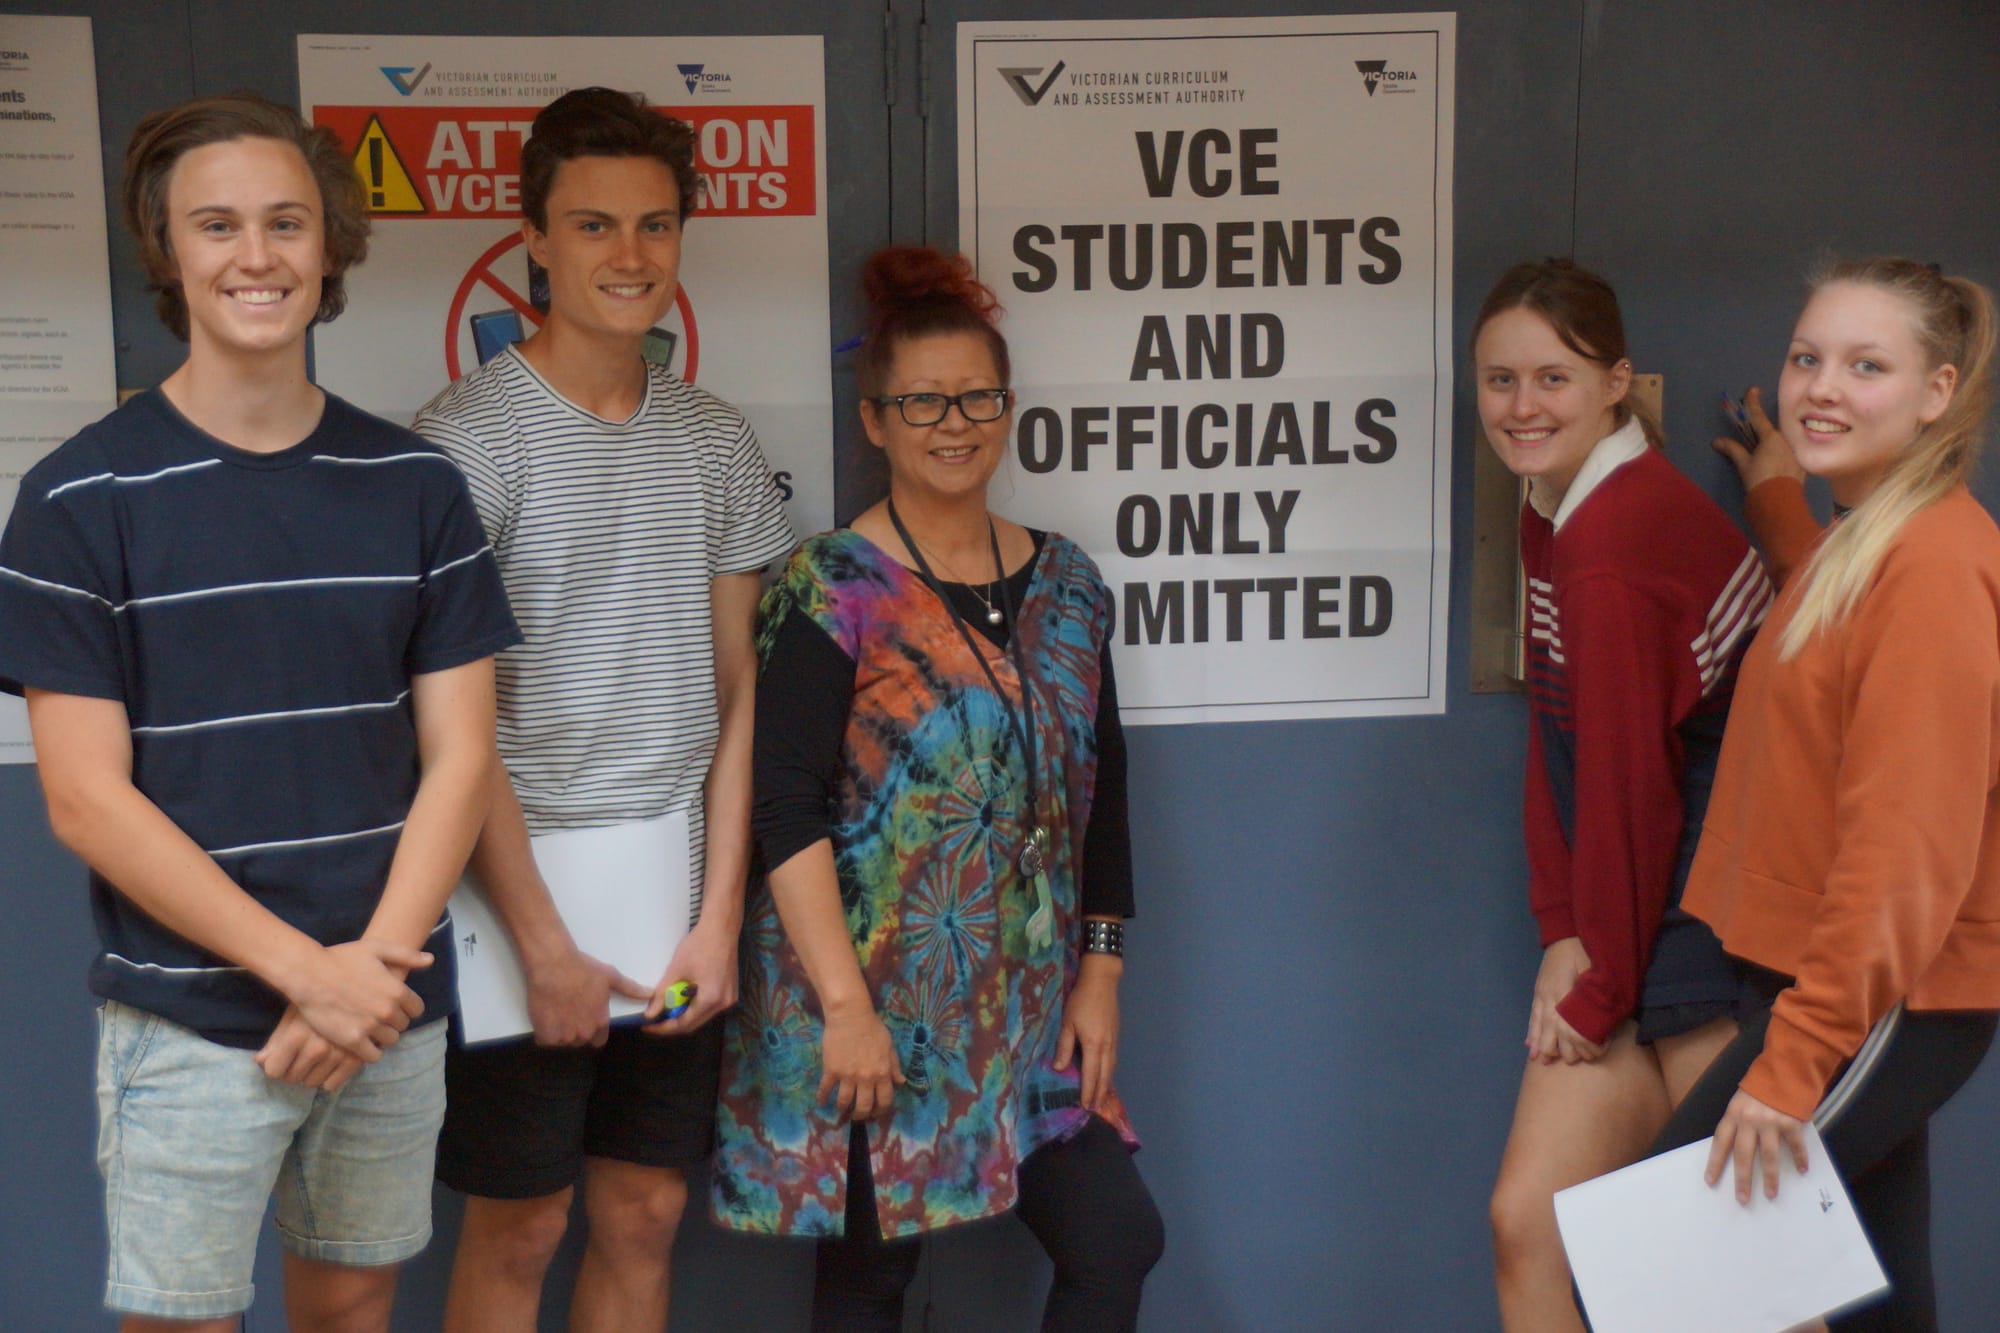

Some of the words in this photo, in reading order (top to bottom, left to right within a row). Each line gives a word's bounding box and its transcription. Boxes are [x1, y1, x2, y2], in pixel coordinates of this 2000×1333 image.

[0, 51, 30, 60] ORIA
[436, 71, 489, 83] VICTORIAN
[494, 71, 558, 83] CURRICULUM
[1070, 72, 1140, 86] VICTORIAN
[1145, 71, 1229, 85] CURRICULUM
[1359, 71, 1417, 81] VICTORIA
[0, 89, 26, 103] nts
[424, 86, 443, 97] AND
[449, 86, 512, 97] ASSESSMENT
[1053, 93, 1079, 106] AND
[1085, 91, 1170, 105] ASSESSMENT
[1176, 90, 1245, 103] AUTHORITY
[1134, 127, 1281, 198] VCE
[426, 173, 522, 212] VCE
[1011, 215, 1403, 293] STUDENTS
[1129, 312, 1286, 382] AND
[1016, 398, 1398, 474] OFFICIALS
[1115, 489, 1302, 558] ONLY
